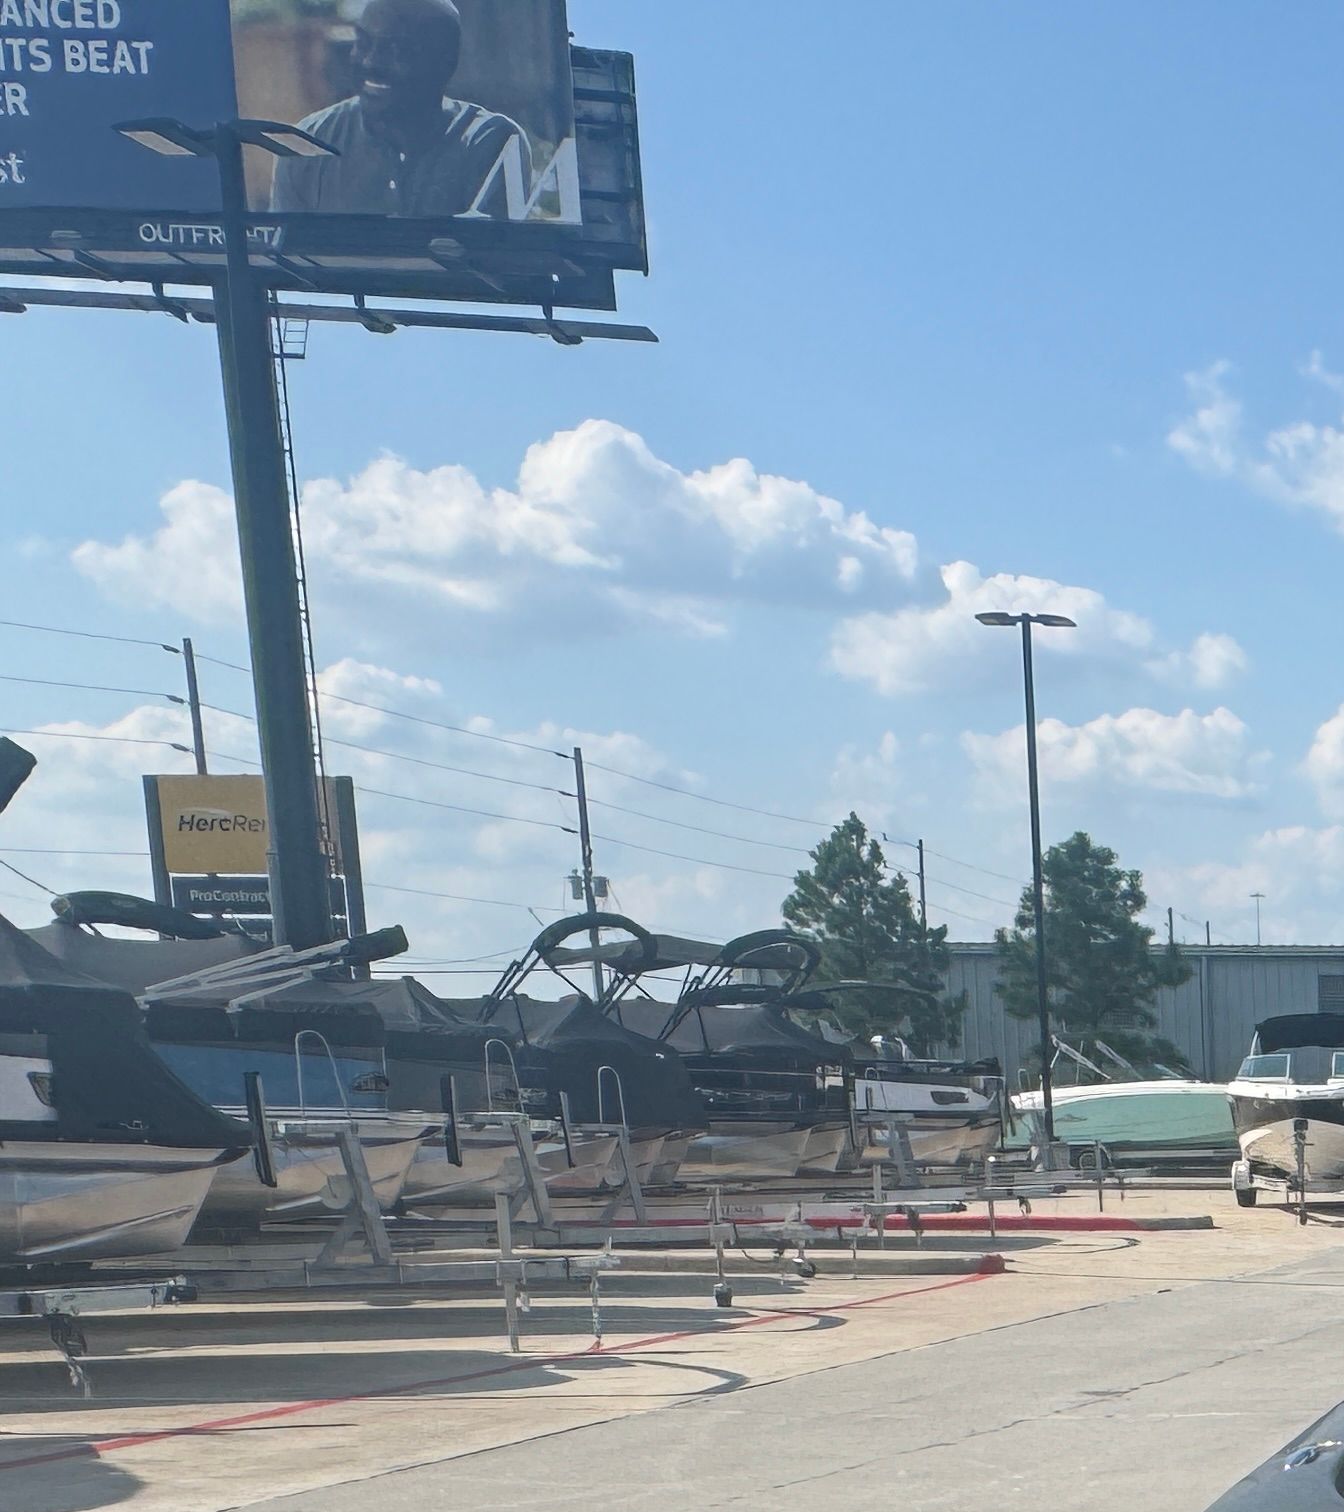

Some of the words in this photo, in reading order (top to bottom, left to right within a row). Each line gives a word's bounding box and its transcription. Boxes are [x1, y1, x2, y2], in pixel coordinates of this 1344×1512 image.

[63, 39, 154, 75] BEAT
[0, 82, 30, 116] R
[178, 814, 265, 832] HercRe
